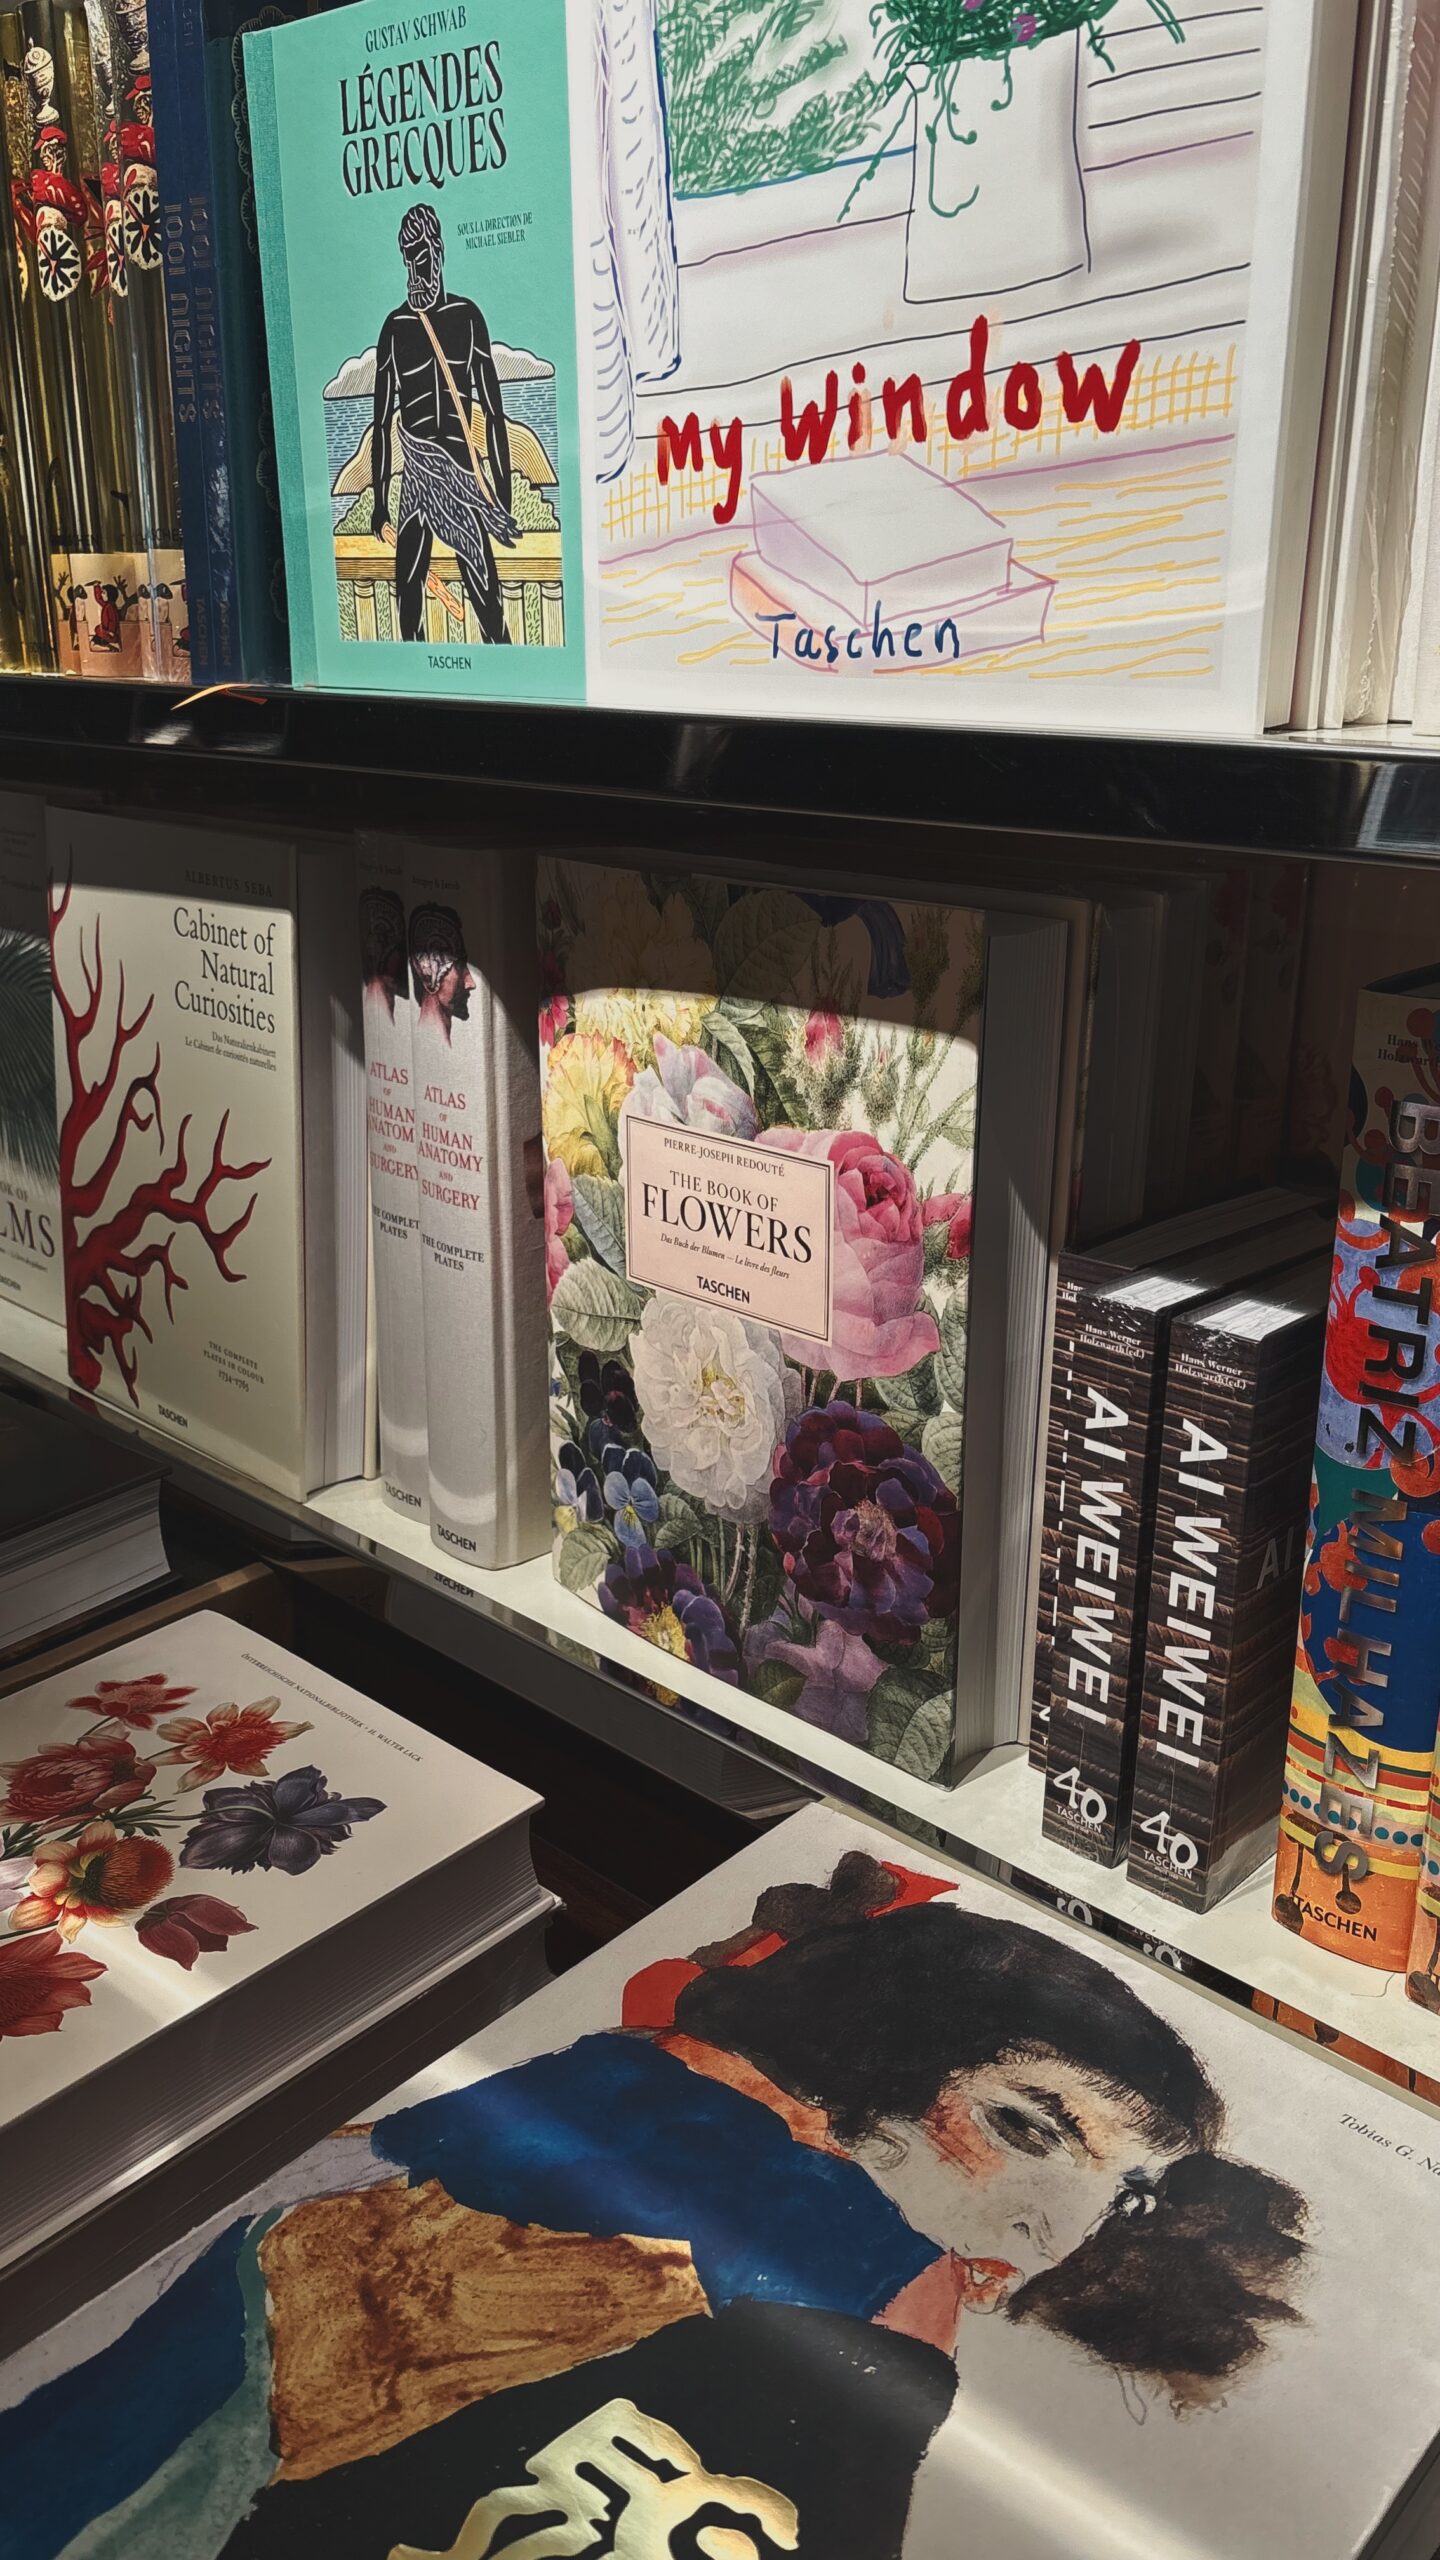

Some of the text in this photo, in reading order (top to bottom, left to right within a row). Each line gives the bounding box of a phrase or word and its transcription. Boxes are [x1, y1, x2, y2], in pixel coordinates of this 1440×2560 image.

[365, 5, 467, 53] GUSTAV SCHWAB
[339, 40, 503, 136] LÉGENDES
[343, 107, 507, 197] GRECQUES
[457, 211, 533, 236] SOUS LA DIRECTION DE
[164, 204, 186, 275] 1001
[465, 229, 526, 250] MICHAEL SIEBLER
[756, 600, 960, 661] Taschen
[427, 655, 472, 670] TASCHEN
[184, 869, 273, 898] ALBERTUS SEBA
[174, 907, 276, 957] Cabinet of
[201, 949, 275, 996] Natural
[175, 980, 276, 1034] Curiosities
[185, 1036, 192, 1047] Le
[212, 1031, 223, 1043] Das
[370, 1062, 408, 1085] ATLAS
[383, 1087, 391, 1097] OF
[424, 1085, 466, 1110] ATLAS
[369, 1097, 415, 1124] HUMAN
[439, 1112, 447, 1122] OF
[367, 1115, 414, 1144] NATOM
[422, 1122, 473, 1151] HUMAN
[383, 1143, 397, 1153] AND
[418, 1141, 483, 1173] ANATOMY
[664, 1137, 785, 1177] PIERRE-JOSEPH REDOUTÉ
[370, 1151, 418, 1181] SURGERY
[439, 1171, 453, 1182] AND
[422, 1179, 480, 1211] SURGERY
[669, 1169, 779, 1212] THE BOOK OF
[372, 1203, 420, 1230] HE COMPLET
[380, 1221, 408, 1240] PLATES
[641, 1182, 812, 1264] FLOWERS
[422, 1233, 485, 1263] THE COMPLETE
[434, 1251, 464, 1272] PLATES
[660, 1232, 790, 1280] Das Buch der Blumen Le livre des fleurs
[697, 1275, 750, 1304] TASCHEN
[1067, 1281, 1083, 1292] Han
[1085, 1324, 1141, 1347] Hans Werner
[208, 1340, 258, 1370] THE COMPLETE
[1181, 1353, 1243, 1377] Hans Werner
[237, 1365, 265, 1384] COLOUR
[158, 1403, 188, 1428] TASCHEN
[385, 1481, 421, 1508] TASCHEN
[1313, 1099, 1440, 1883] BEATRIZ MILHAZES
[437, 1523, 477, 1552] TASCHEN
[1067, 1386, 1128, 1726] AI WEIWEI
[1156, 1418, 1228, 1769] AI WEIWEI
[377, 1733, 404, 1752] WALTER
[403, 1748, 424, 1762] LACK
[1053, 1767, 1107, 1825] 40
[1056, 1804, 1101, 1834] TASCHEN
[1140, 1811, 1198, 1870] 40
[1143, 1849, 1192, 1880] TASCHEN
[1294, 1895, 1377, 1942] TASCHEN
[1339, 2113, 1440, 2176] Tobias G. Na
